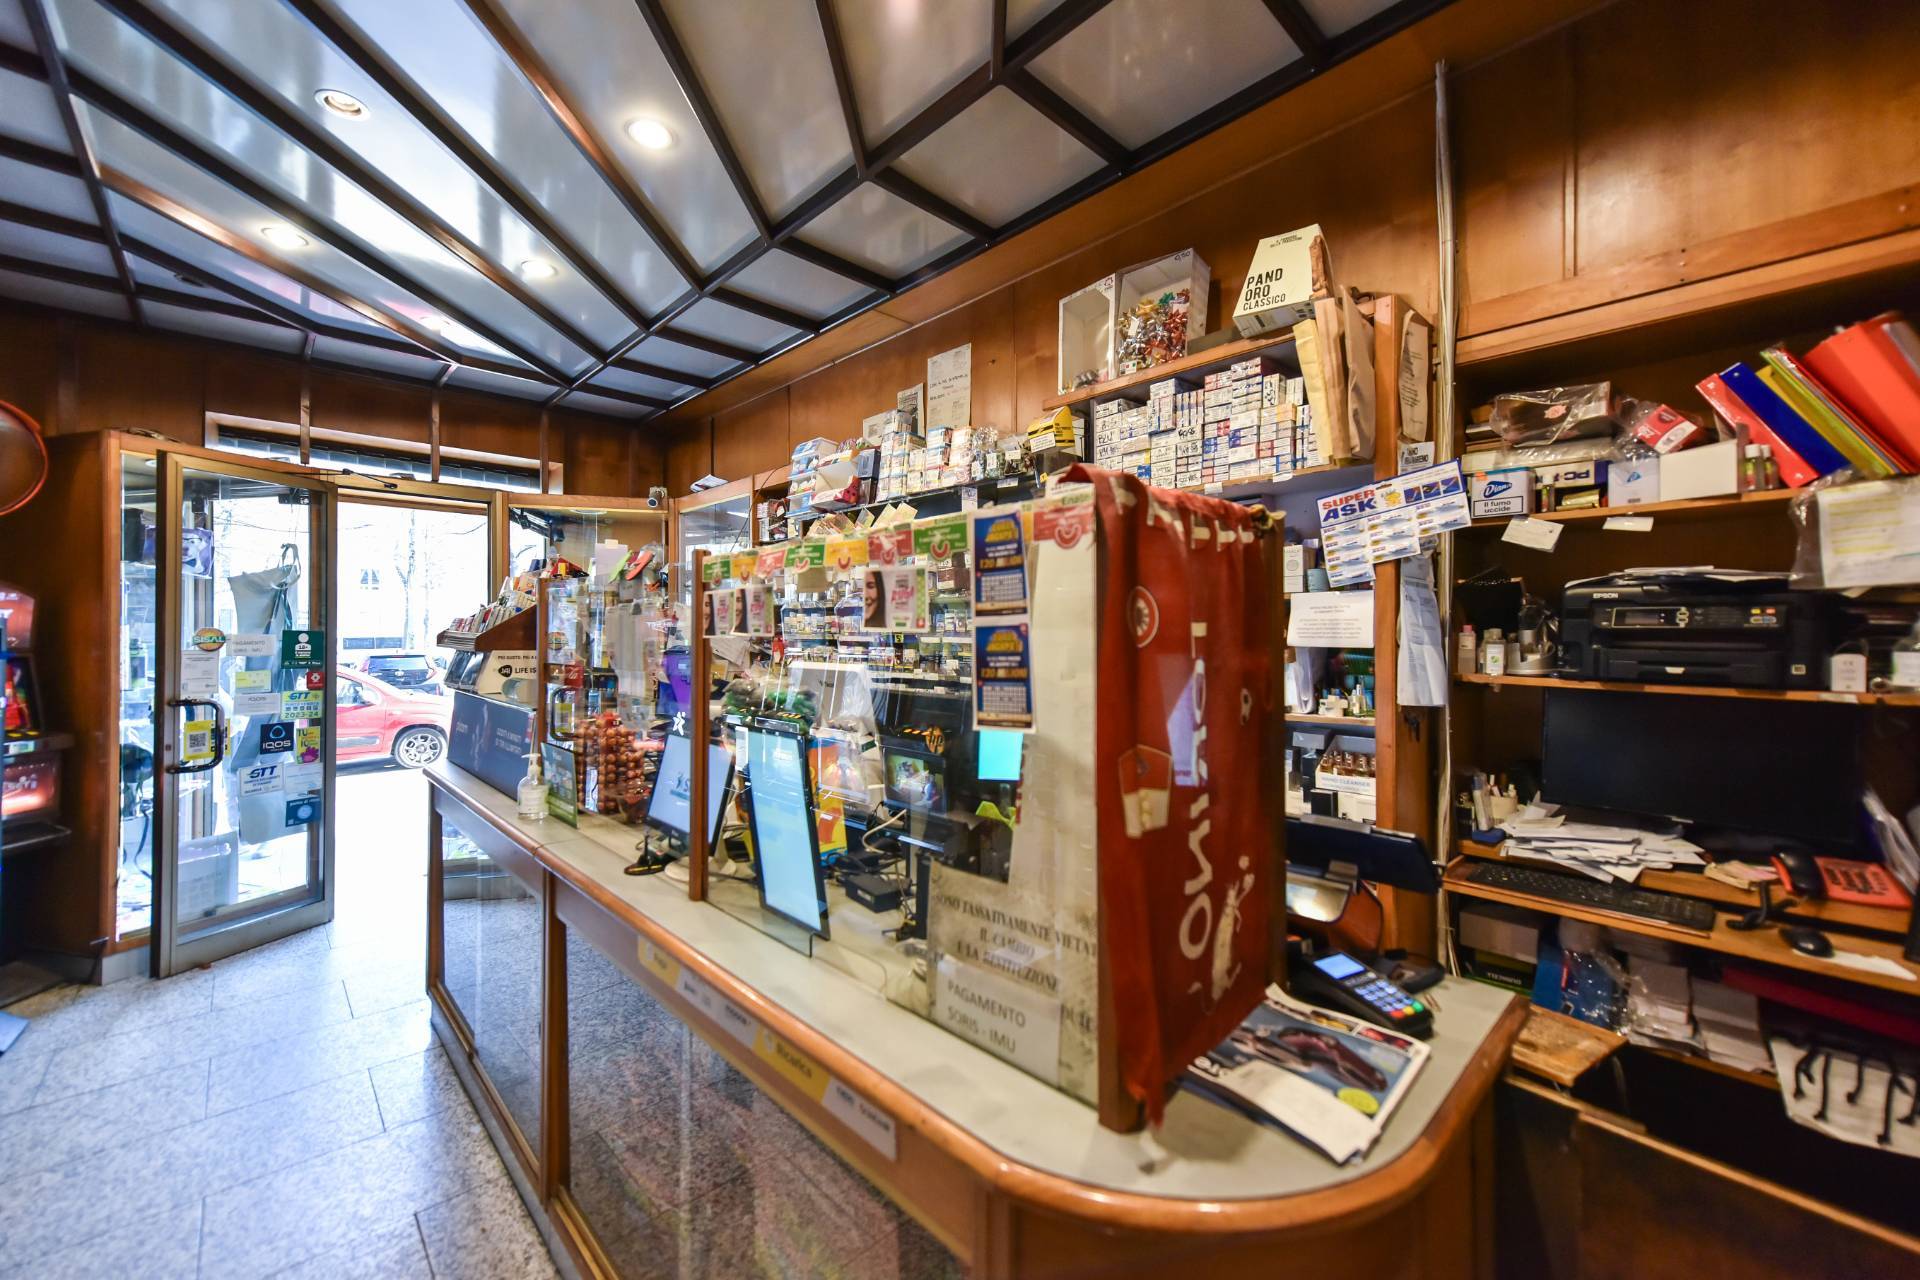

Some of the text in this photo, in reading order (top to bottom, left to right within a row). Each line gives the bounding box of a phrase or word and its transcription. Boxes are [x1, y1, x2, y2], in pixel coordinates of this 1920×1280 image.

[1247, 268, 1283, 289] PAND
[1243, 293, 1286, 311] CLASSICO
[1245, 285, 1271, 301] ORO
[1484, 481, 1512, 497] Diana
[1322, 489, 1375, 510] SUPER
[1322, 498, 1376, 522] ASK
[193, 635, 226, 644] SISAL
[262, 739, 292, 750] IQOS
[249, 765, 278, 778] GTT
[948, 980, 1026, 1028] PAGAMENTO
[990, 1029, 1016, 1054] IMU
